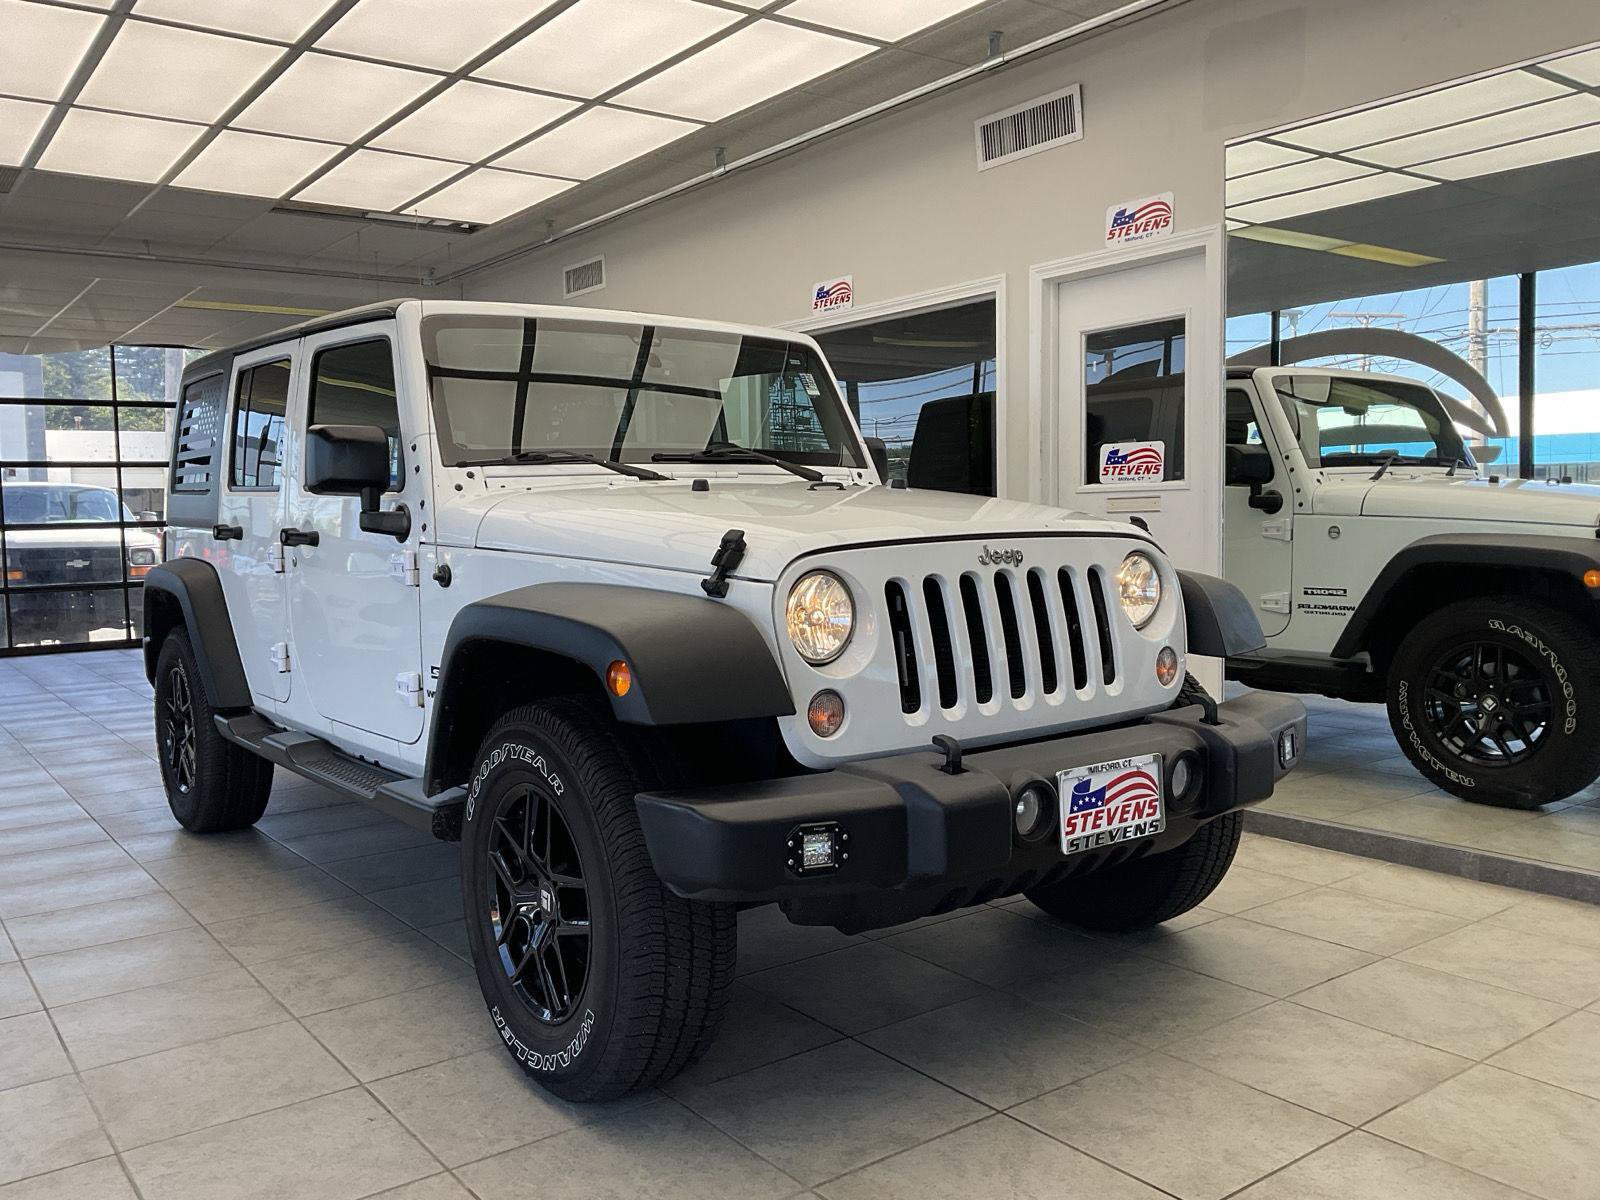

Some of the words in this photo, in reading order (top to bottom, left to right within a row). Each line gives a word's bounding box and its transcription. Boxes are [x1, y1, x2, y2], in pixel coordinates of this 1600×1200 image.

[1106, 215, 1172, 241] STEVENS
[813, 293, 851, 310] STEVENS
[1101, 464, 1162, 476] STEVENS
[978, 544, 1024, 568] Jeep
[1122, 759, 1132, 768] CT
[466, 743, 564, 821] GOODYEAR
[1065, 797, 1159, 837] STEVENS
[1069, 819, 1161, 853] STEVENS
[491, 1006, 596, 1072] WRANGLER
